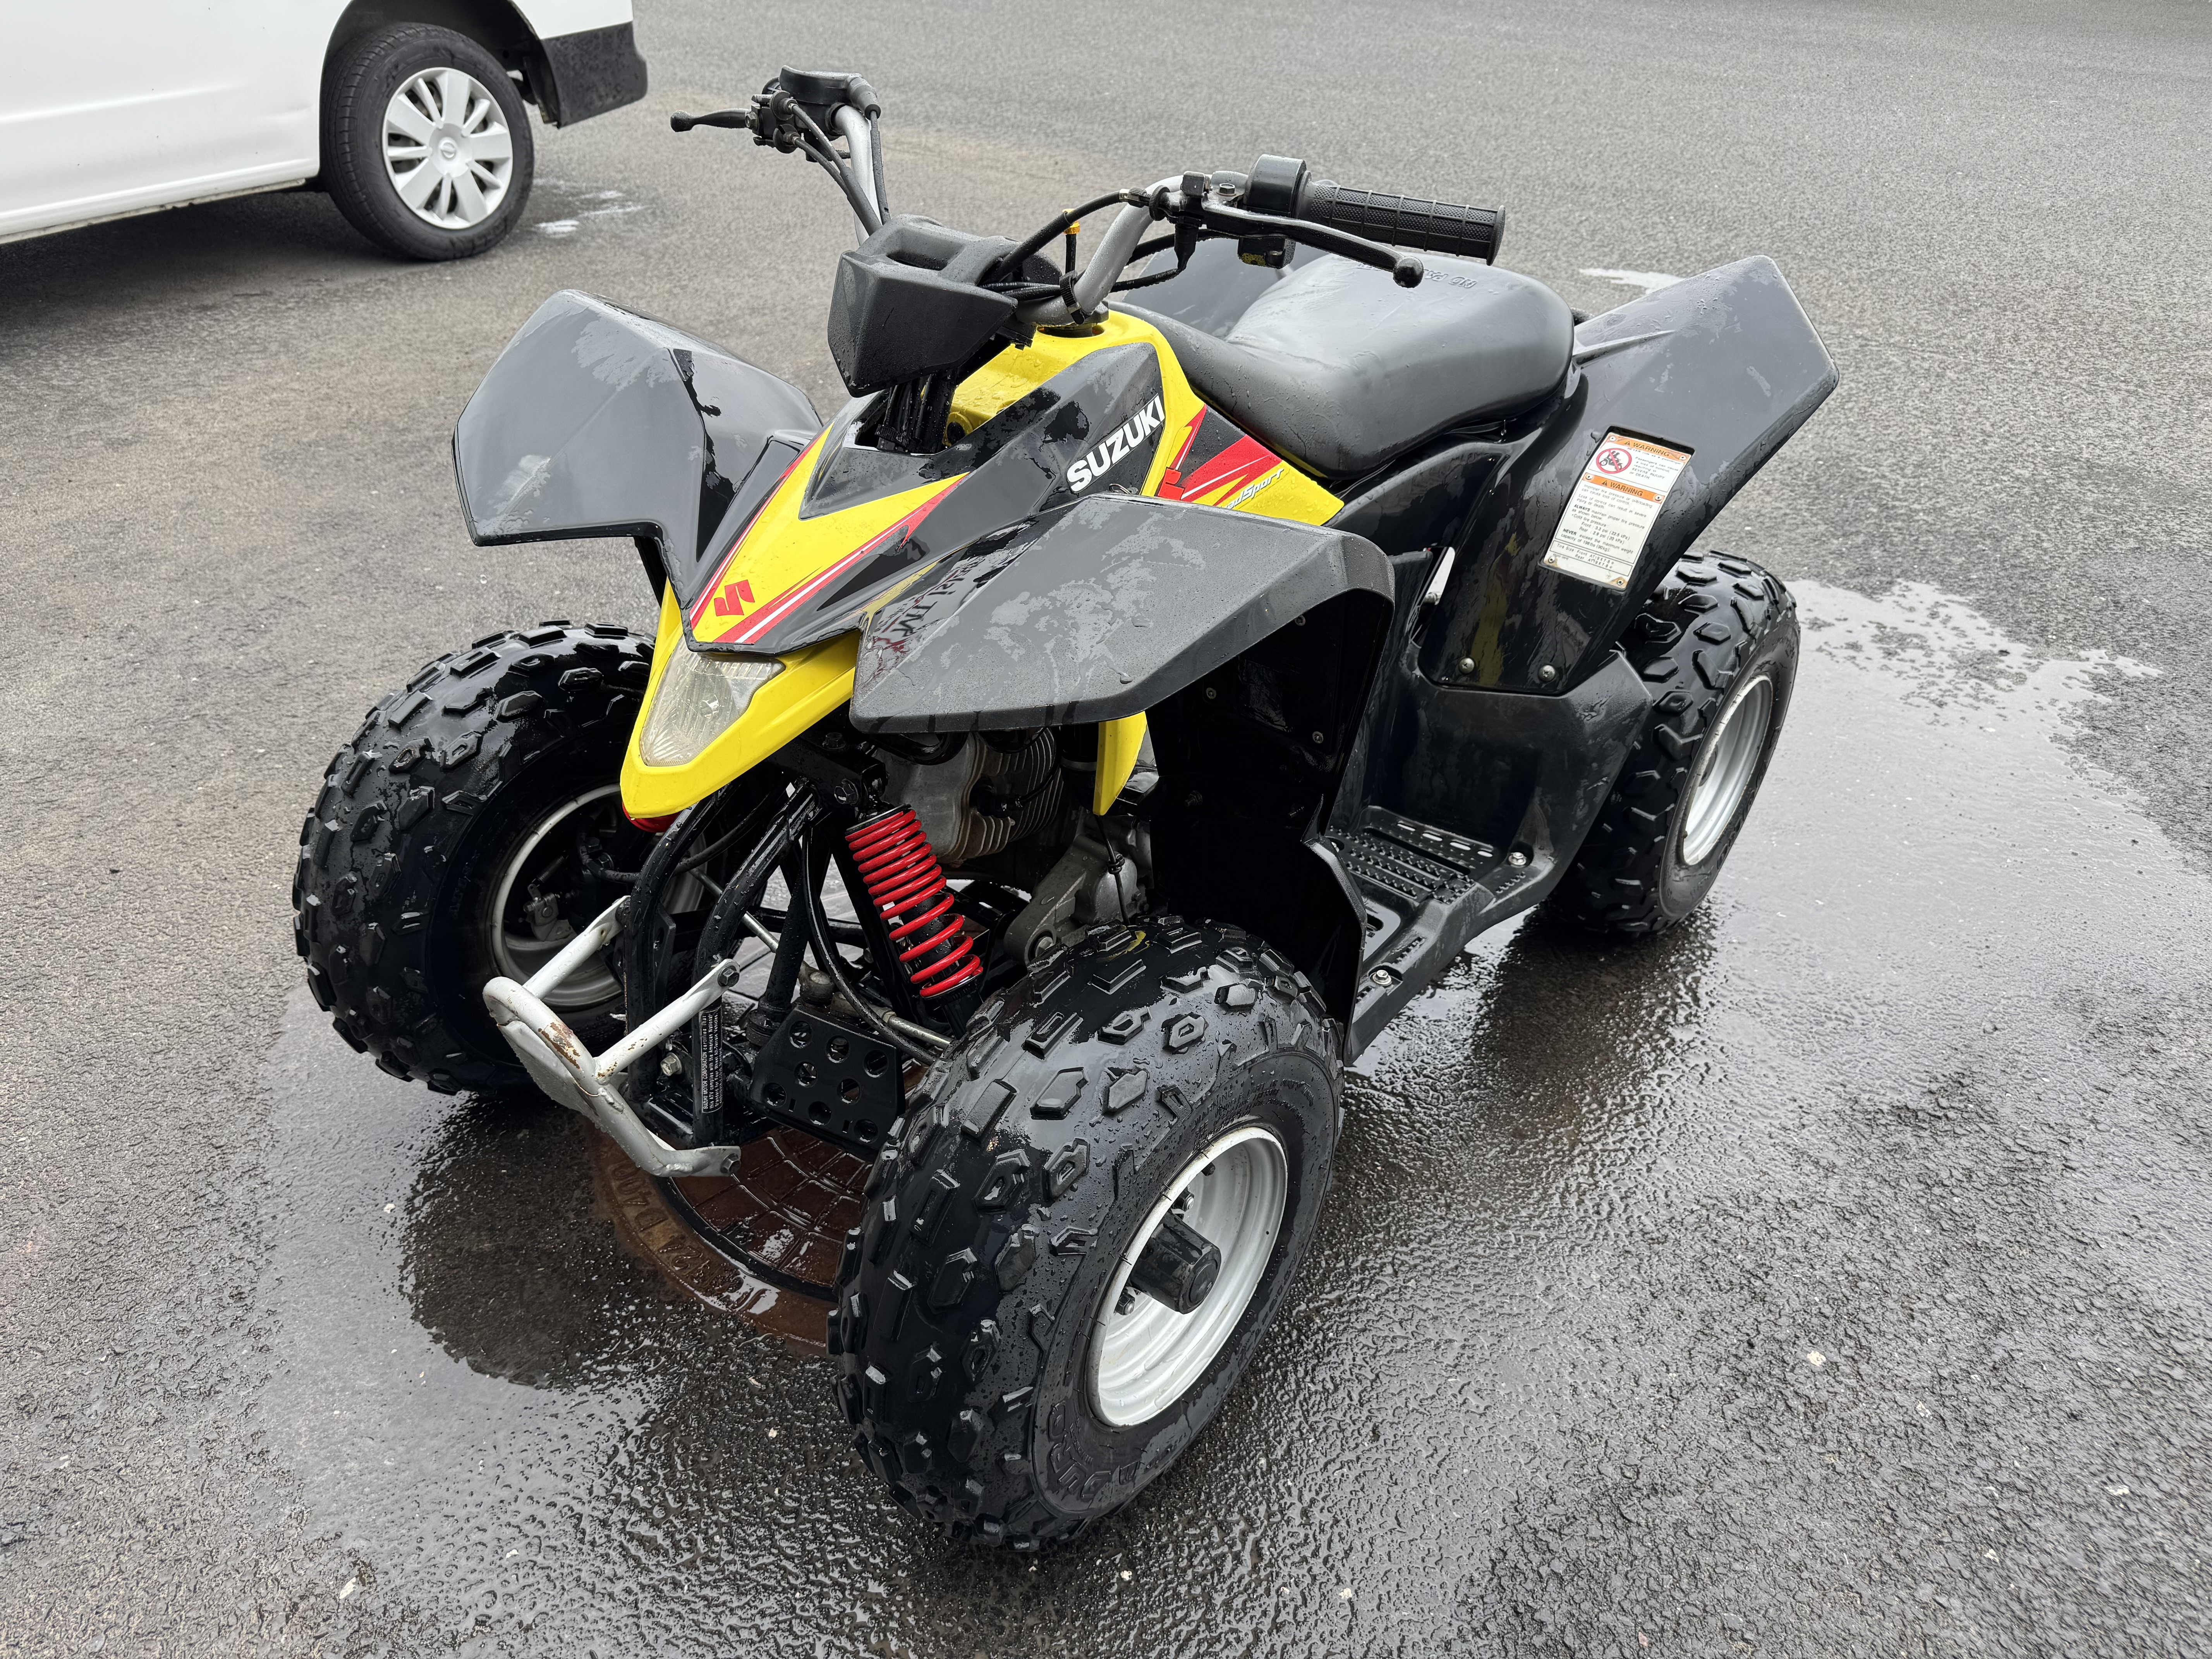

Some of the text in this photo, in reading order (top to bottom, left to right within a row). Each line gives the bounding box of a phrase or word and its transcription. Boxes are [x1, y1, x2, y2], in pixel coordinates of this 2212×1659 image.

[1067, 395, 1165, 492] SUZUKI
[1632, 442, 1670, 457] WARNING
[1226, 468, 1284, 509] adSport
[1609, 482, 1644, 496] WARNING
[1628, 521, 1645, 529] pressure
[1560, 533, 1576, 541] capacity
[1602, 541, 1620, 550] maximum
[1048, 1400, 1111, 1498] DURO
